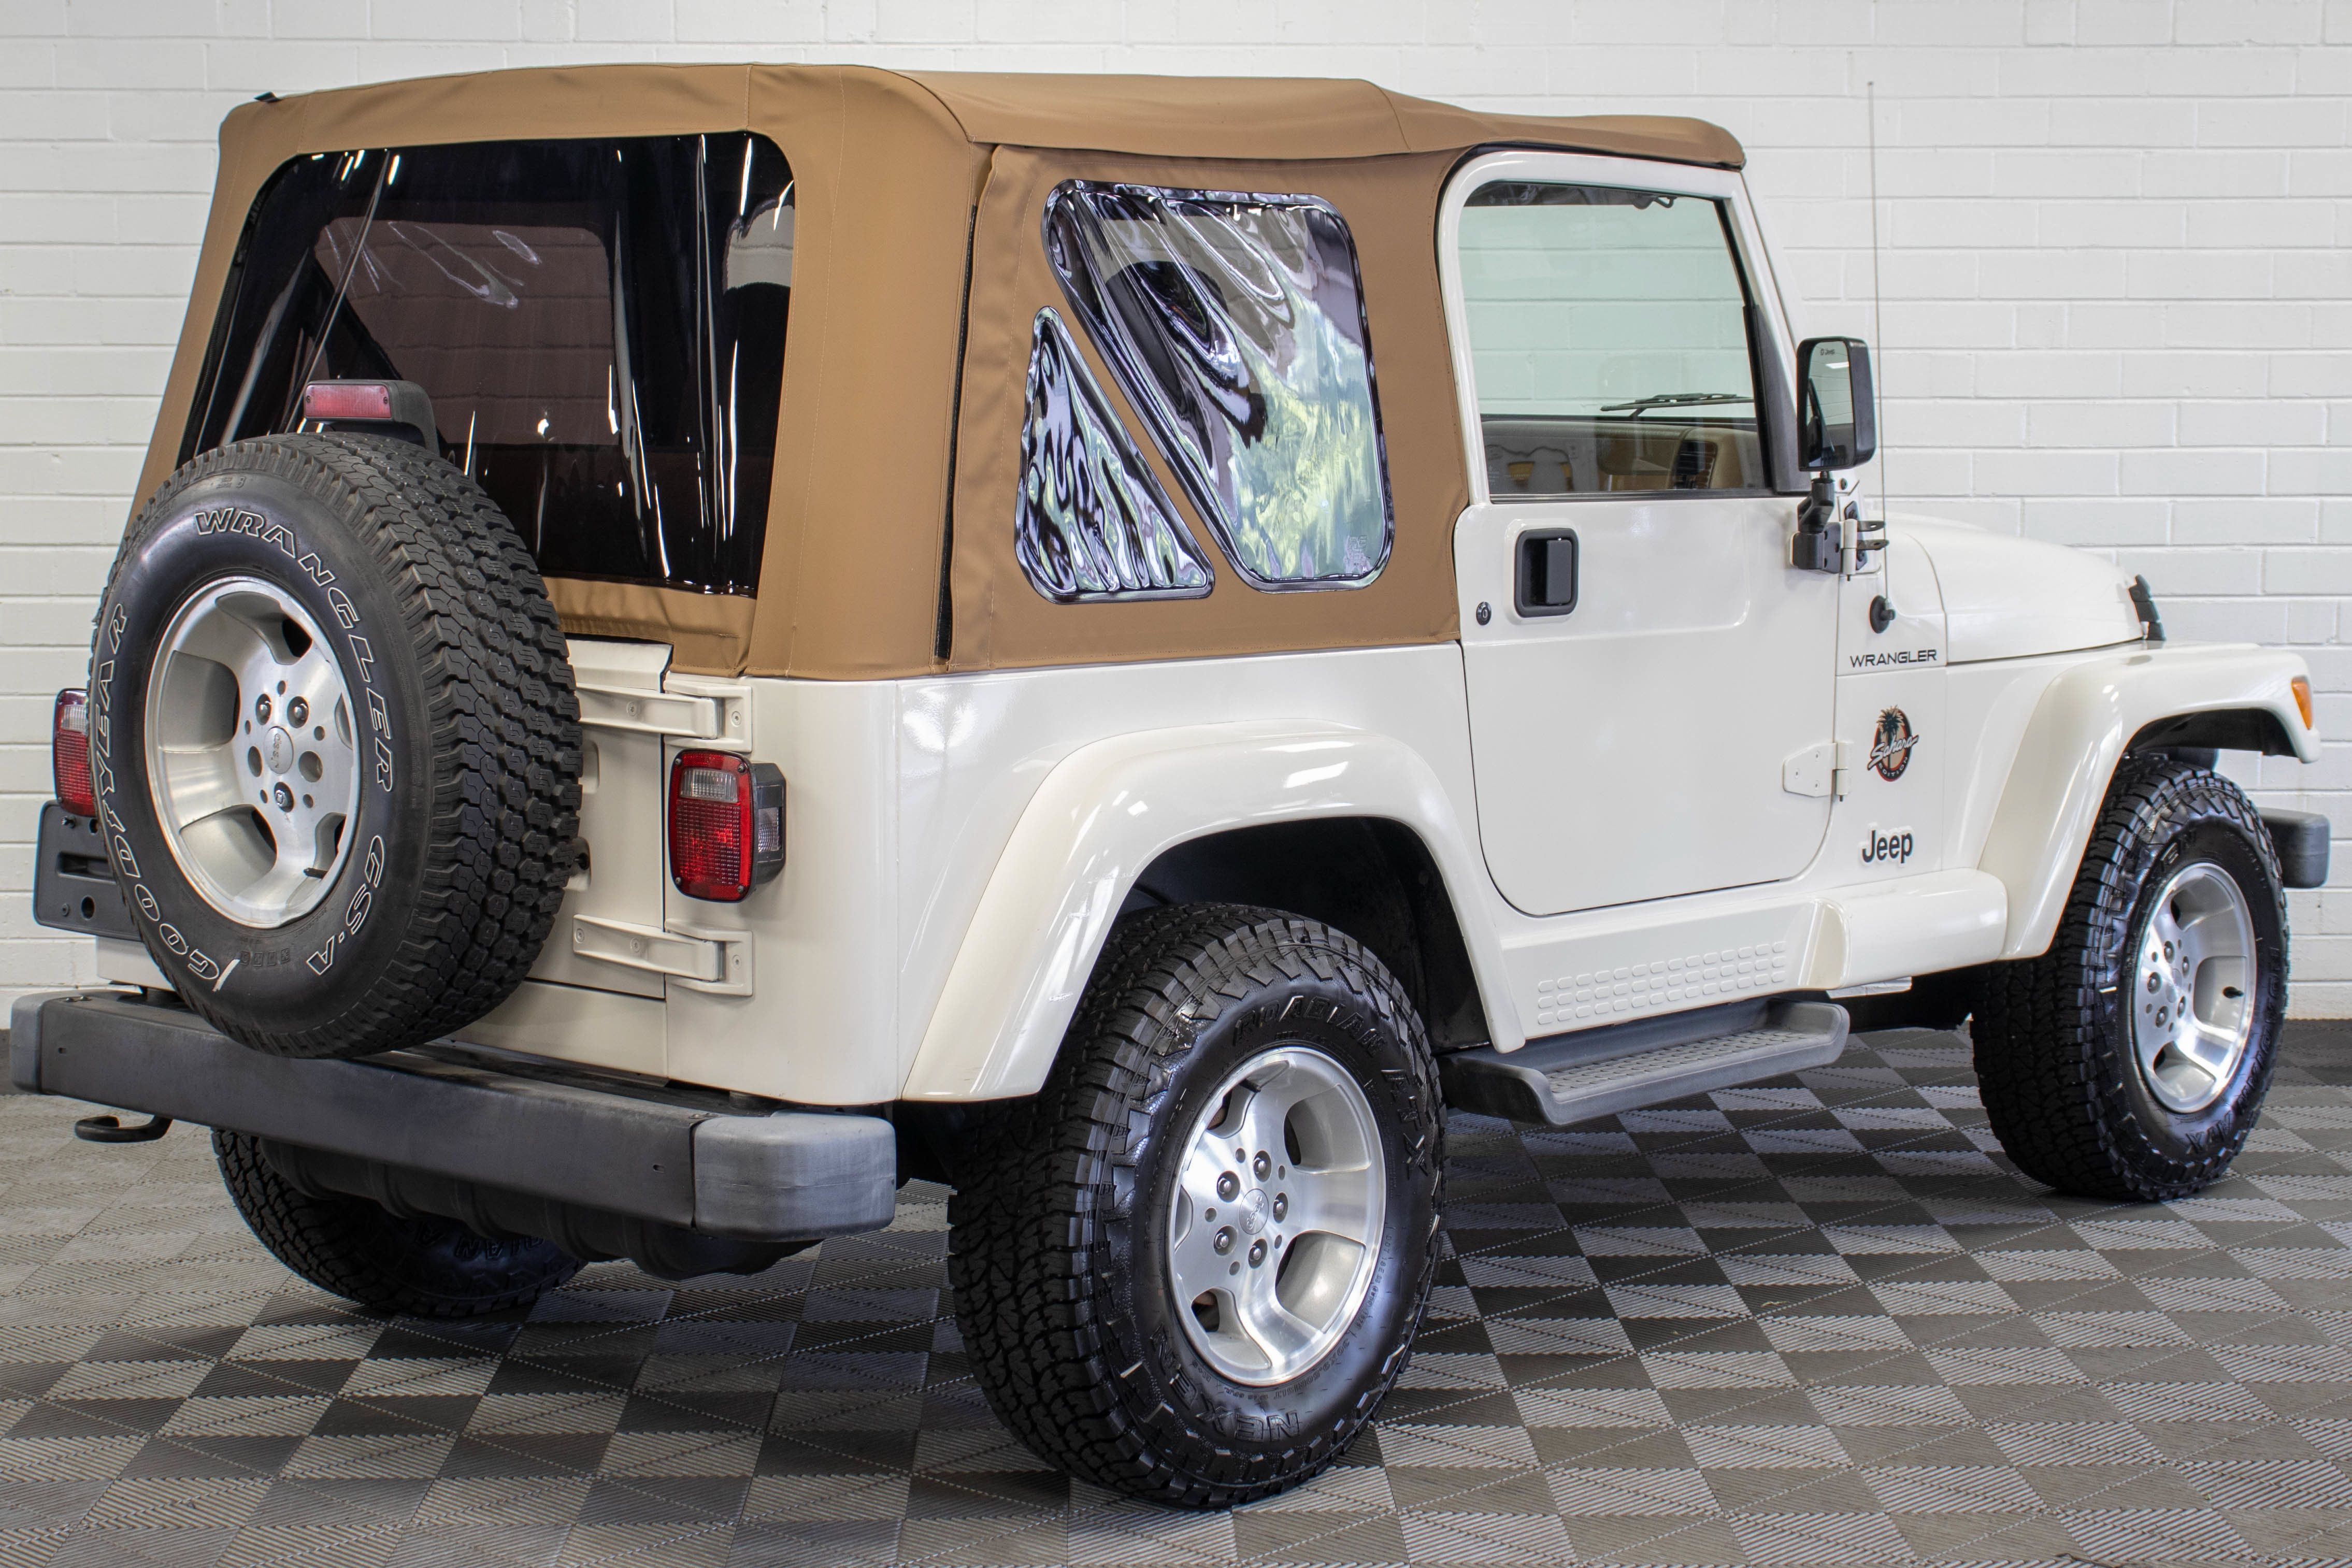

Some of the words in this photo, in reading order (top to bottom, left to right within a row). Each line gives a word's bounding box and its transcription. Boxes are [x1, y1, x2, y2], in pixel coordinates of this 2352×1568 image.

[194, 507, 395, 793] WRANGLER
[1850, 649, 1937, 667] WRANGLER
[271, 733, 281, 768] Jeep
[1868, 734, 1919, 771] Sahara
[1878, 756, 1909, 776] EDITION
[98, 603, 220, 980] GOODYEAR
[1862, 830, 1913, 864] Jeep
[1246, 1196, 1264, 1230] Jeep
[1150, 1322, 1300, 1442] NEXEN
